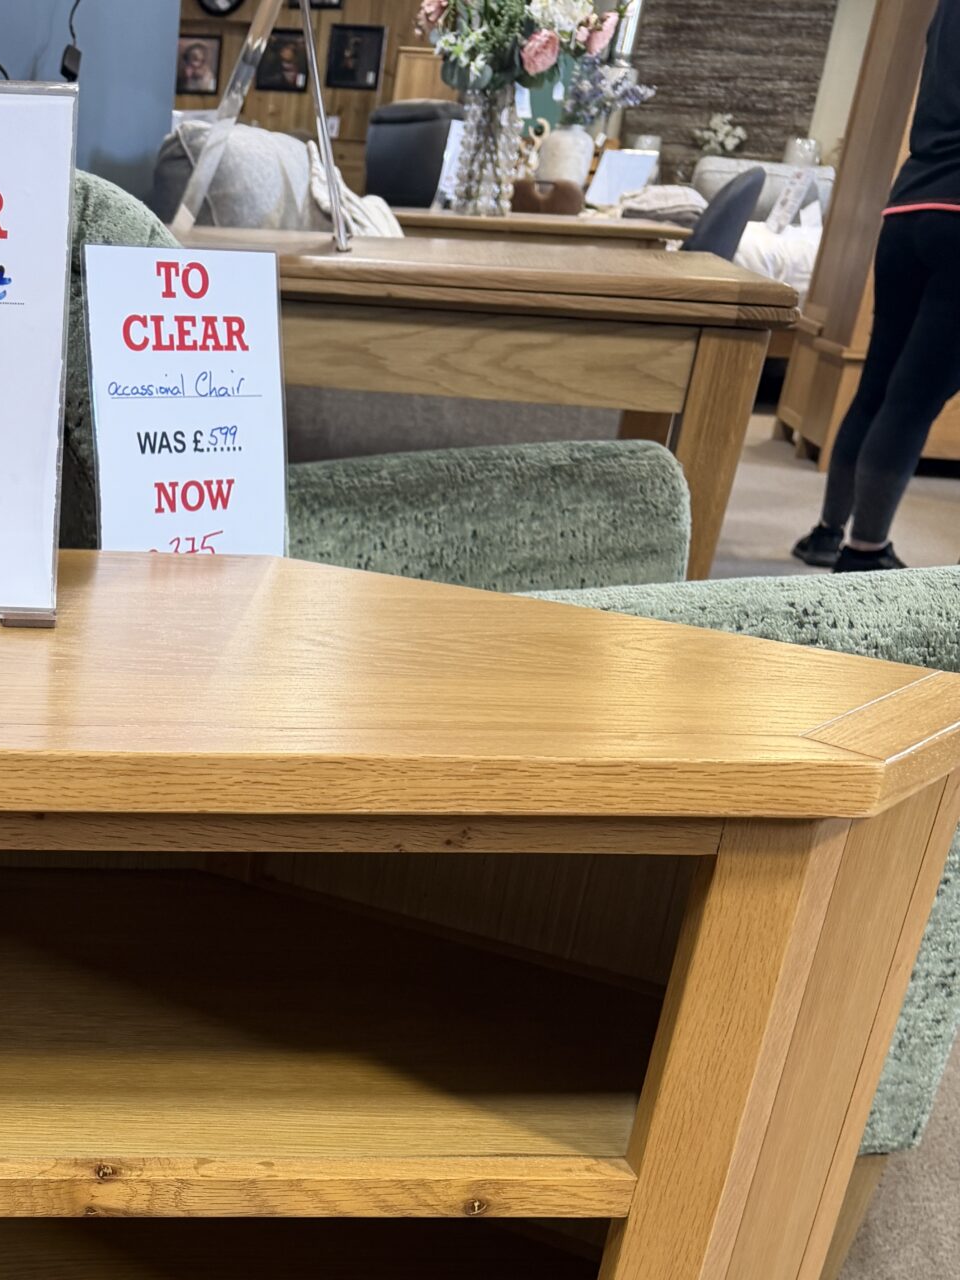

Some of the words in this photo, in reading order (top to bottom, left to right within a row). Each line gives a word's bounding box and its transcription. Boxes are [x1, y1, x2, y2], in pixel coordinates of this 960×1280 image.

[156, 261, 209, 299] TO
[122, 314, 249, 351] CLEAR
[195, 369, 245, 397] Chair
[137, 430, 186, 454] WAS
[154, 478, 235, 513] NOW
